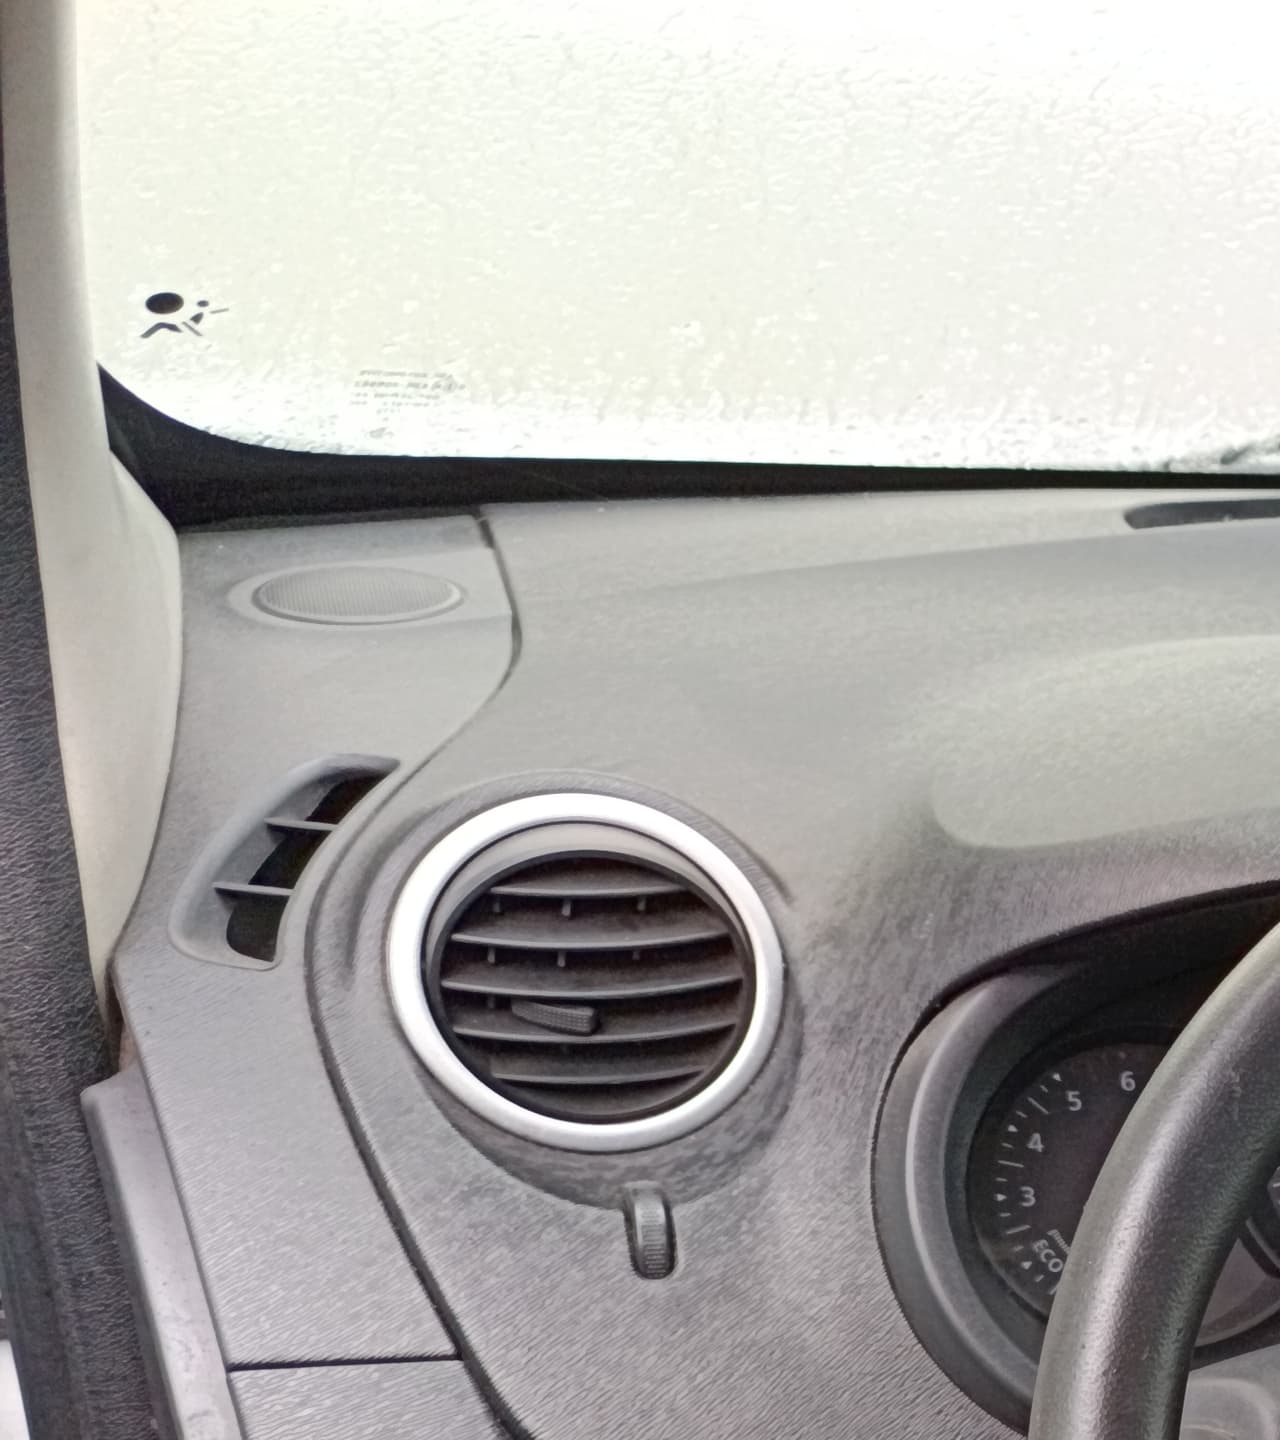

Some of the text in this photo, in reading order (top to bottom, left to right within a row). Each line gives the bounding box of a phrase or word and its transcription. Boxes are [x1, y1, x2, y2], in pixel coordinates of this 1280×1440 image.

[1119, 1071, 1136, 1091] 6
[1065, 1090, 1082, 1111] 5
[1026, 1132, 1044, 1152] 4
[1020, 1186, 1036, 1207] 3
[1031, 1239, 1064, 1273] ECO
